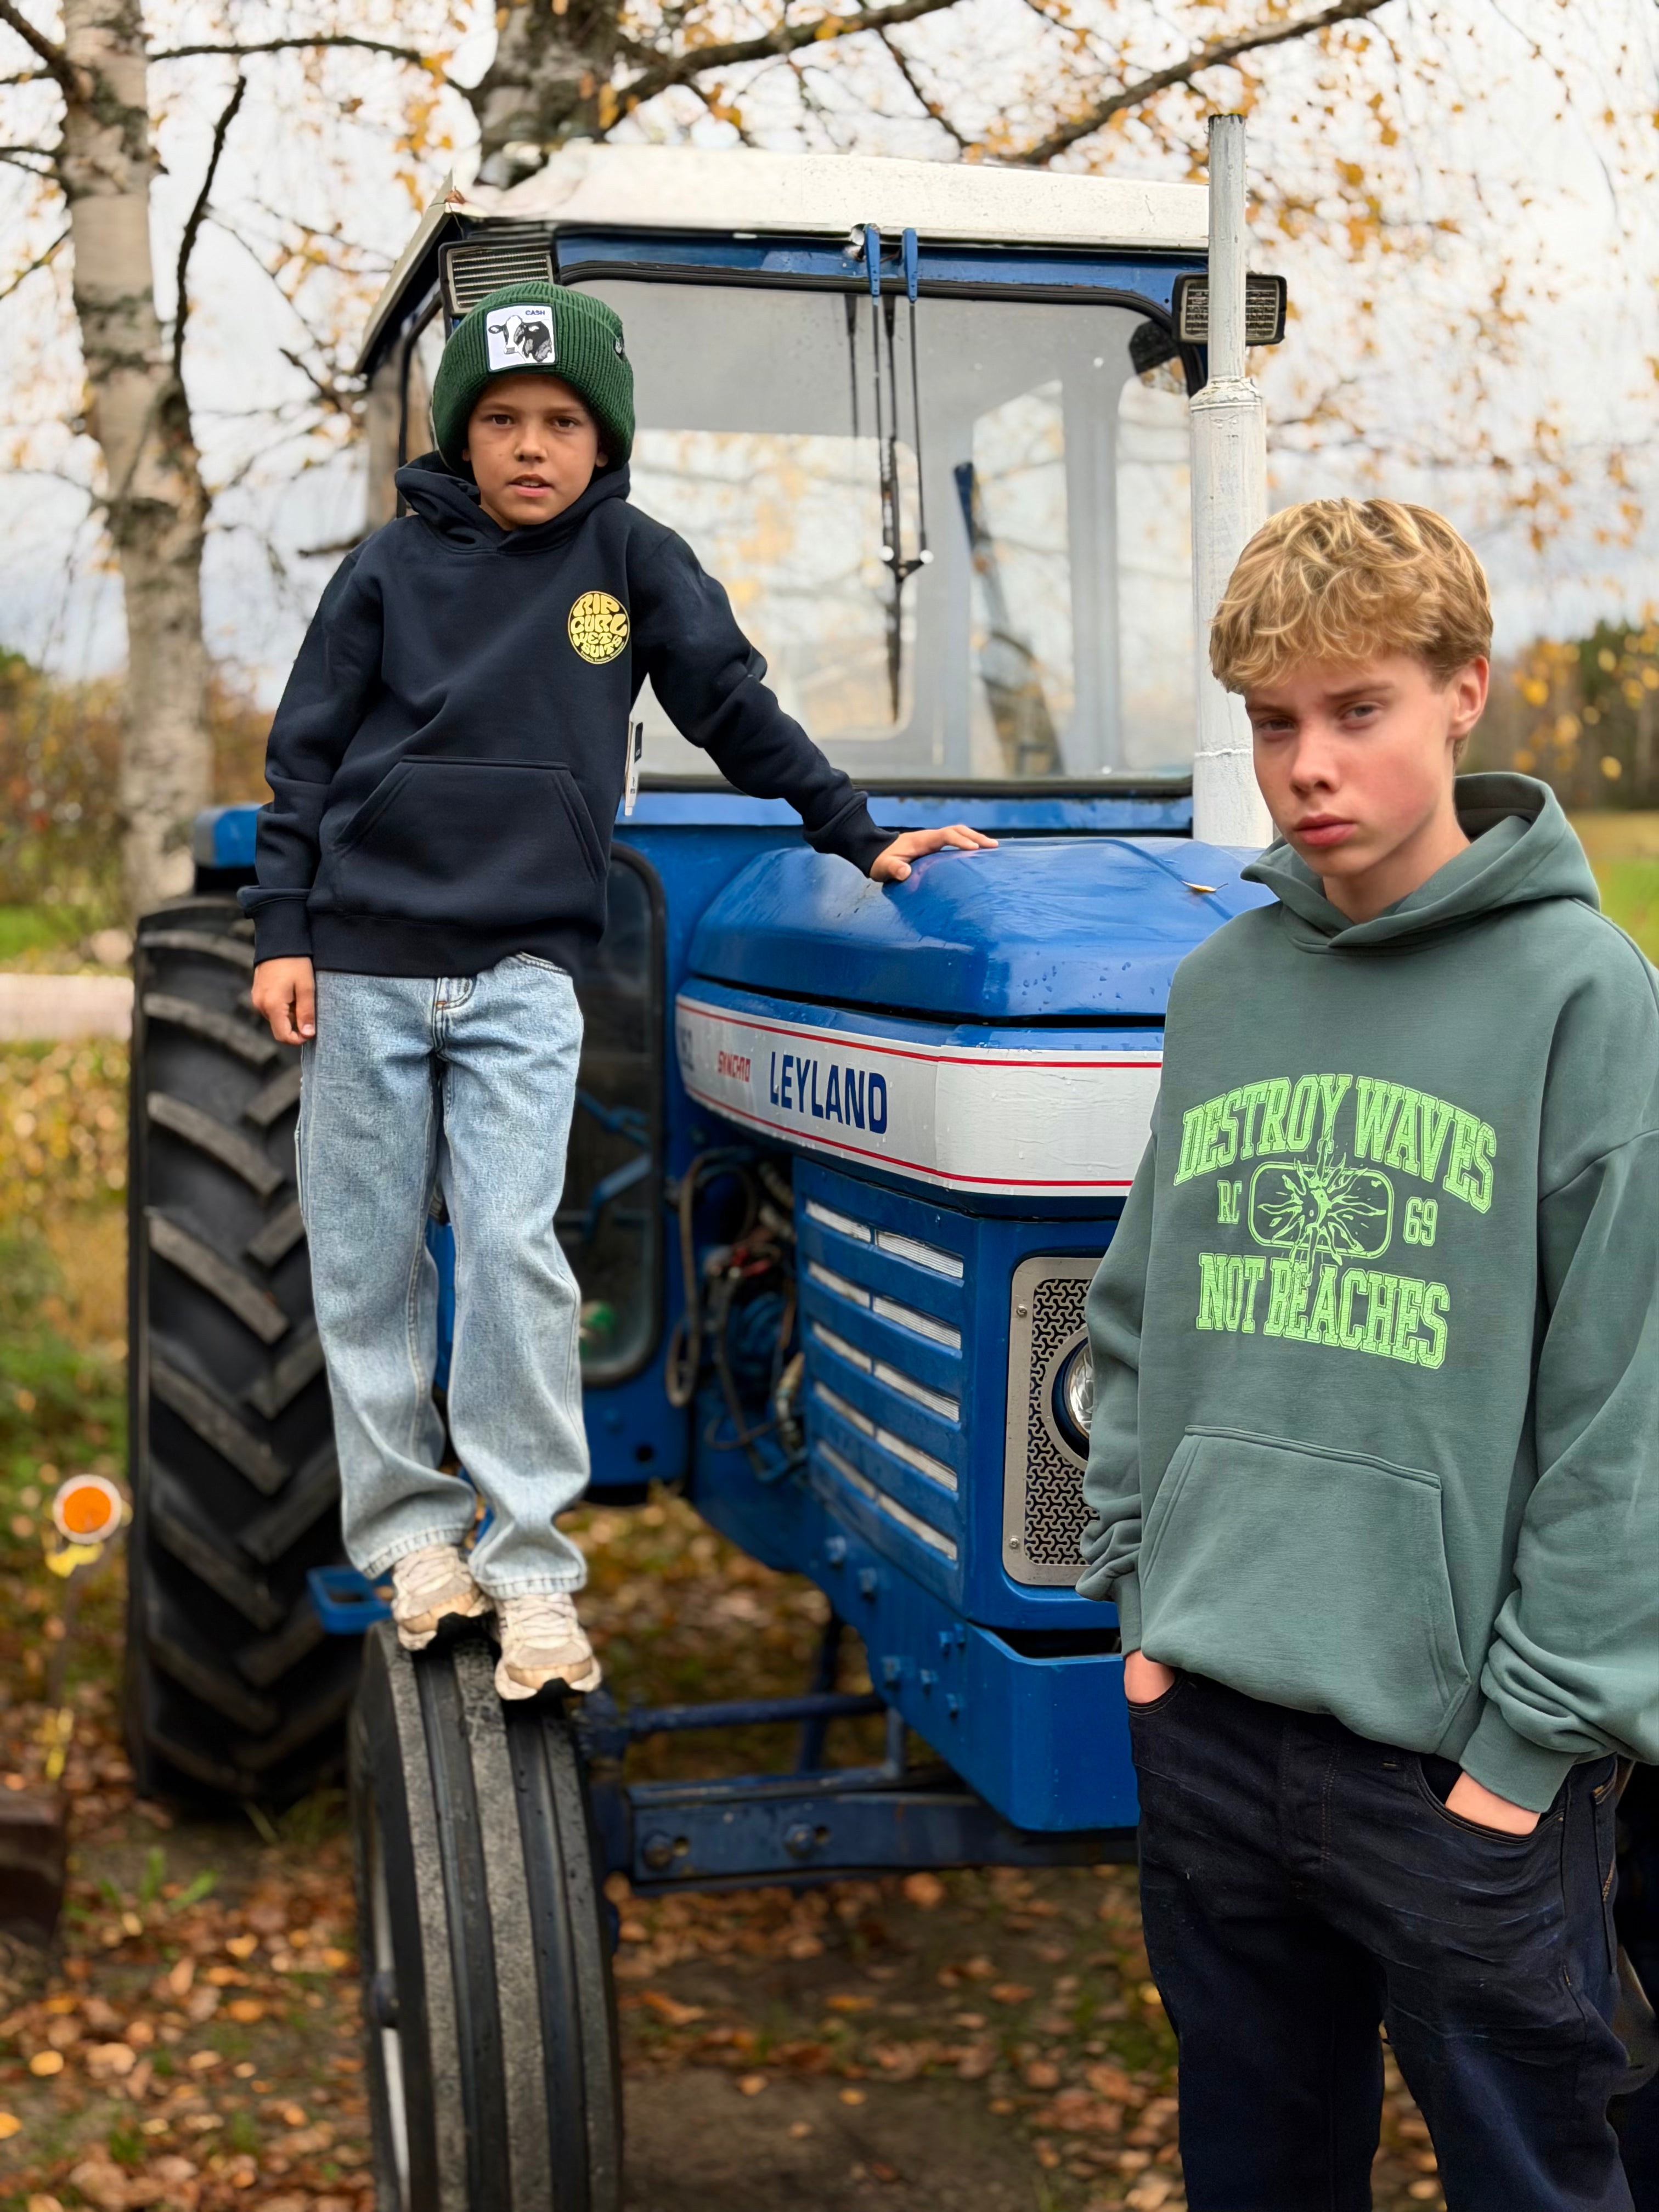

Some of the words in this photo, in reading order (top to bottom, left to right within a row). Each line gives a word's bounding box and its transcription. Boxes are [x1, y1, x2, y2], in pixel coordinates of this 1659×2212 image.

[571, 613, 628, 637] CURL
[573, 594, 619, 616] RIP
[573, 632, 612, 646] WET
[580, 635, 622, 658] SUITS
[770, 1051, 887, 1135] LEYLAND
[1173, 1074, 1352, 1186] DESTROY
[1355, 1076, 1497, 1214] WAVES
[1217, 1180, 1242, 1224] RC
[1403, 1197, 1438, 1246] 69
[1196, 1253, 1266, 1333] NOT
[1263, 1258, 1449, 1369] BEACHES
